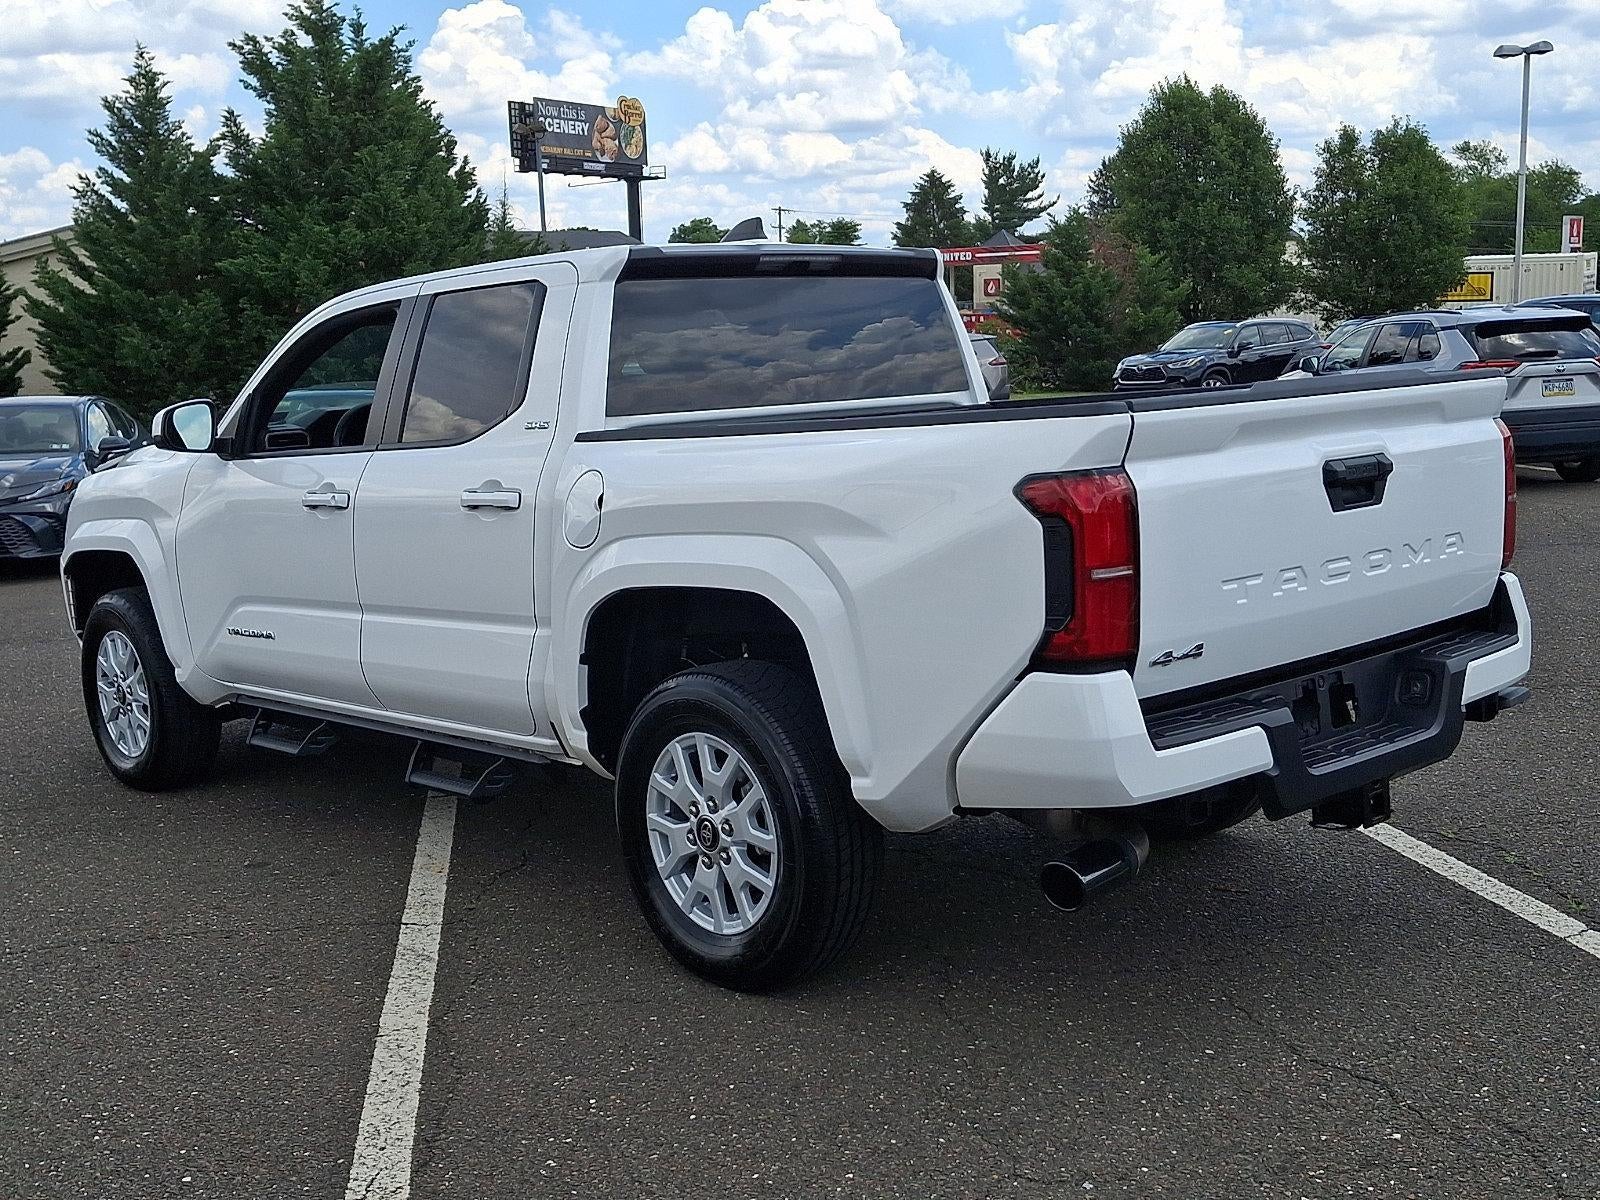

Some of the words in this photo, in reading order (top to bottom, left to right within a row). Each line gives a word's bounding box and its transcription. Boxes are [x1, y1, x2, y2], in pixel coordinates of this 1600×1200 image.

[537, 101, 559, 117] Now
[560, 105, 577, 119] this
[577, 106, 586, 120] is
[1220, 531, 1465, 604] TACOMA
[226, 626, 276, 641] TACOMA
